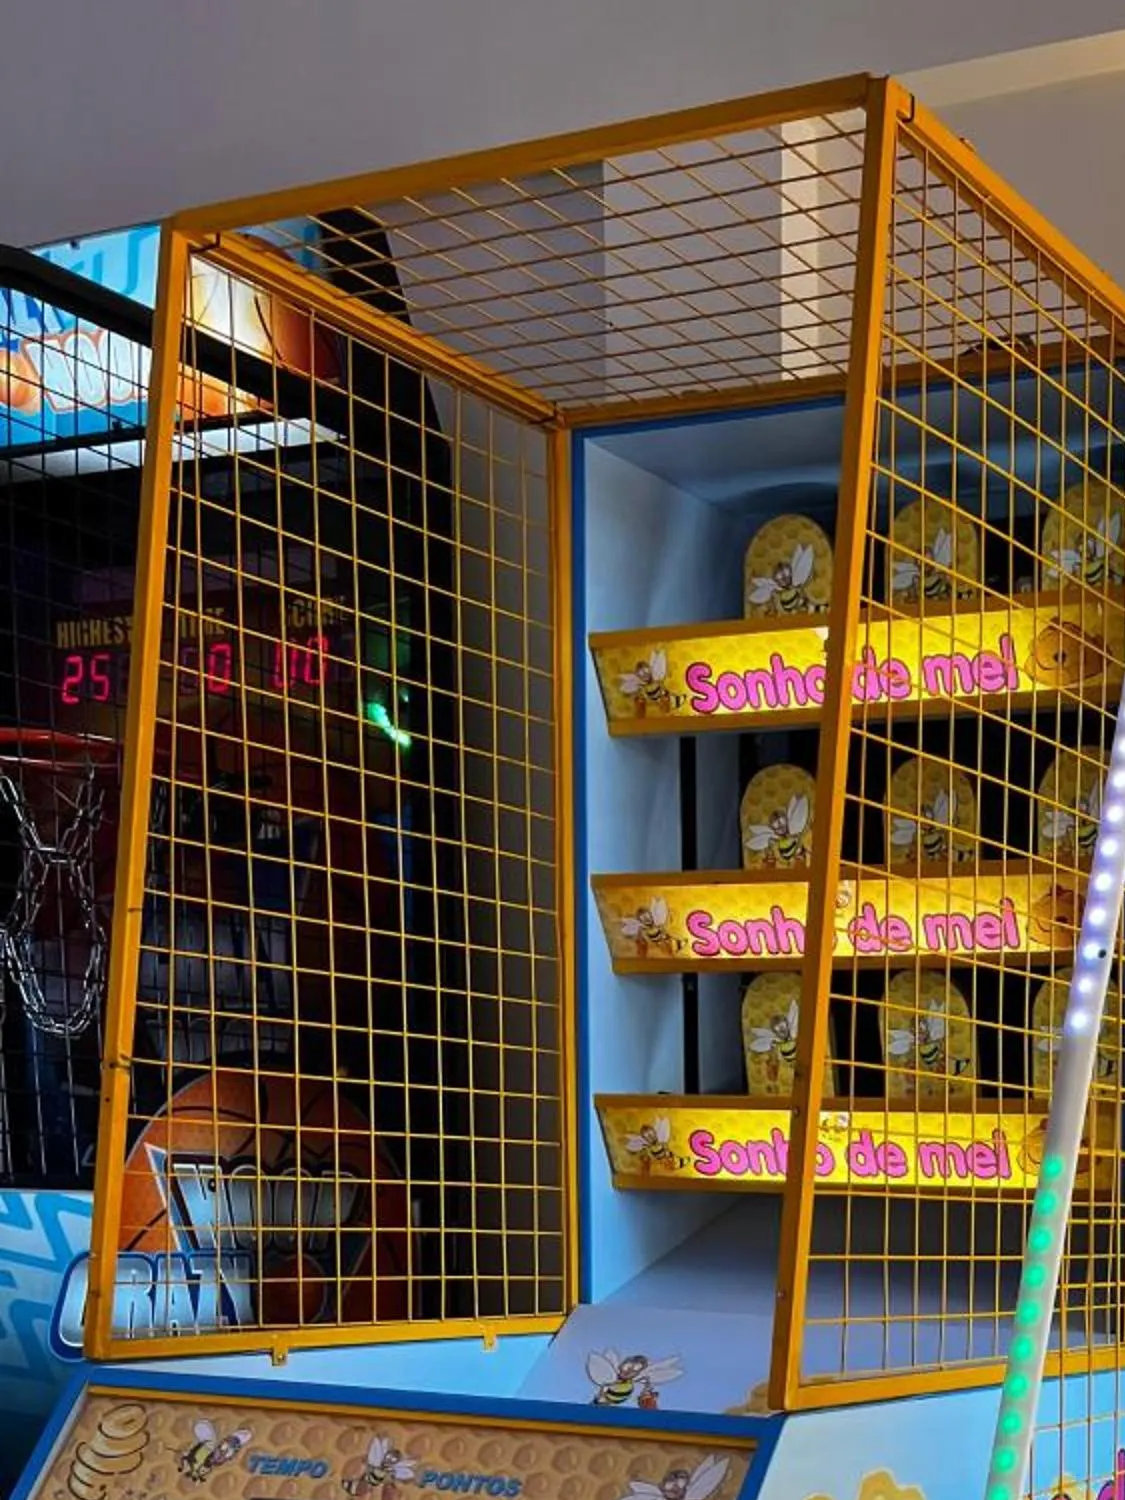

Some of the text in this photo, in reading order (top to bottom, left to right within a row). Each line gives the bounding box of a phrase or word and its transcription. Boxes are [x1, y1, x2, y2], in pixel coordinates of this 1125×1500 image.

[685, 632, 1019, 714] Sonho de mel
[686, 896, 1021, 957] Sonh de mel
[846, 1129, 909, 1178] de
[917, 1127, 1013, 1181] mel
[248, 1454, 523, 1498] TEMPO PONTOS
